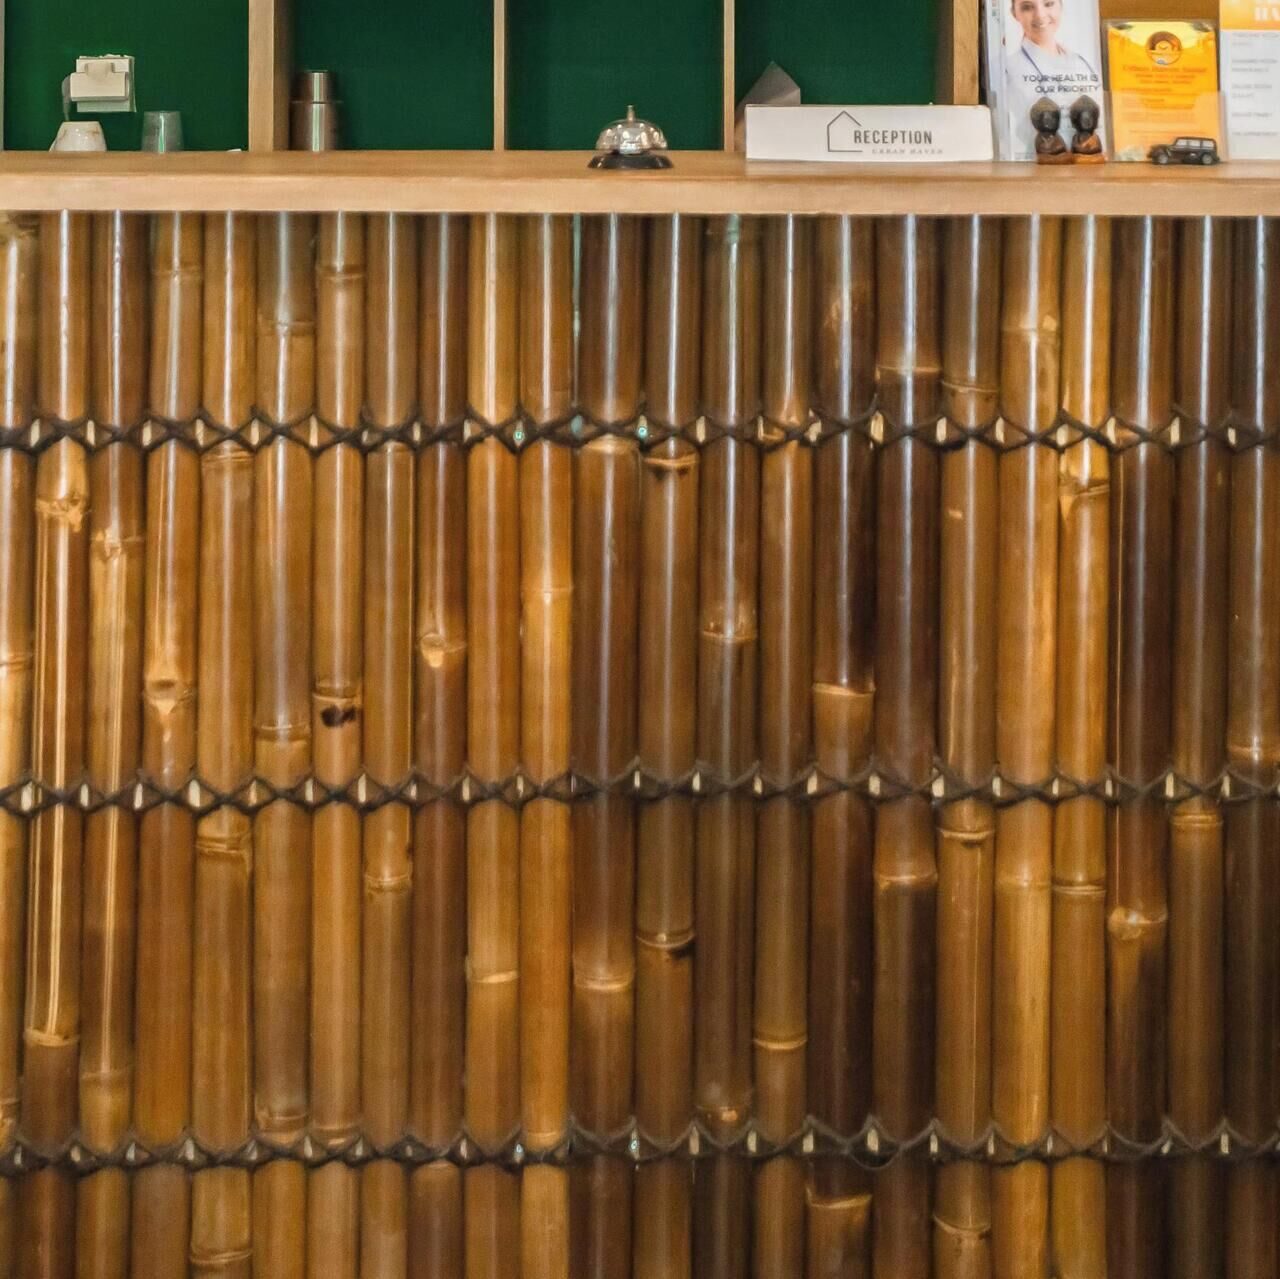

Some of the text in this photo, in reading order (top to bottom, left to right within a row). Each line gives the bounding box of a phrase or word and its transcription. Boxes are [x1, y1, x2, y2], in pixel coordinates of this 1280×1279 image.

[1023, 74, 1049, 82] YOUR
[1051, 74, 1088, 82] HEALTH
[1035, 84, 1098, 93] OUR PRIORITY
[854, 130, 932, 144] RECEPTION
